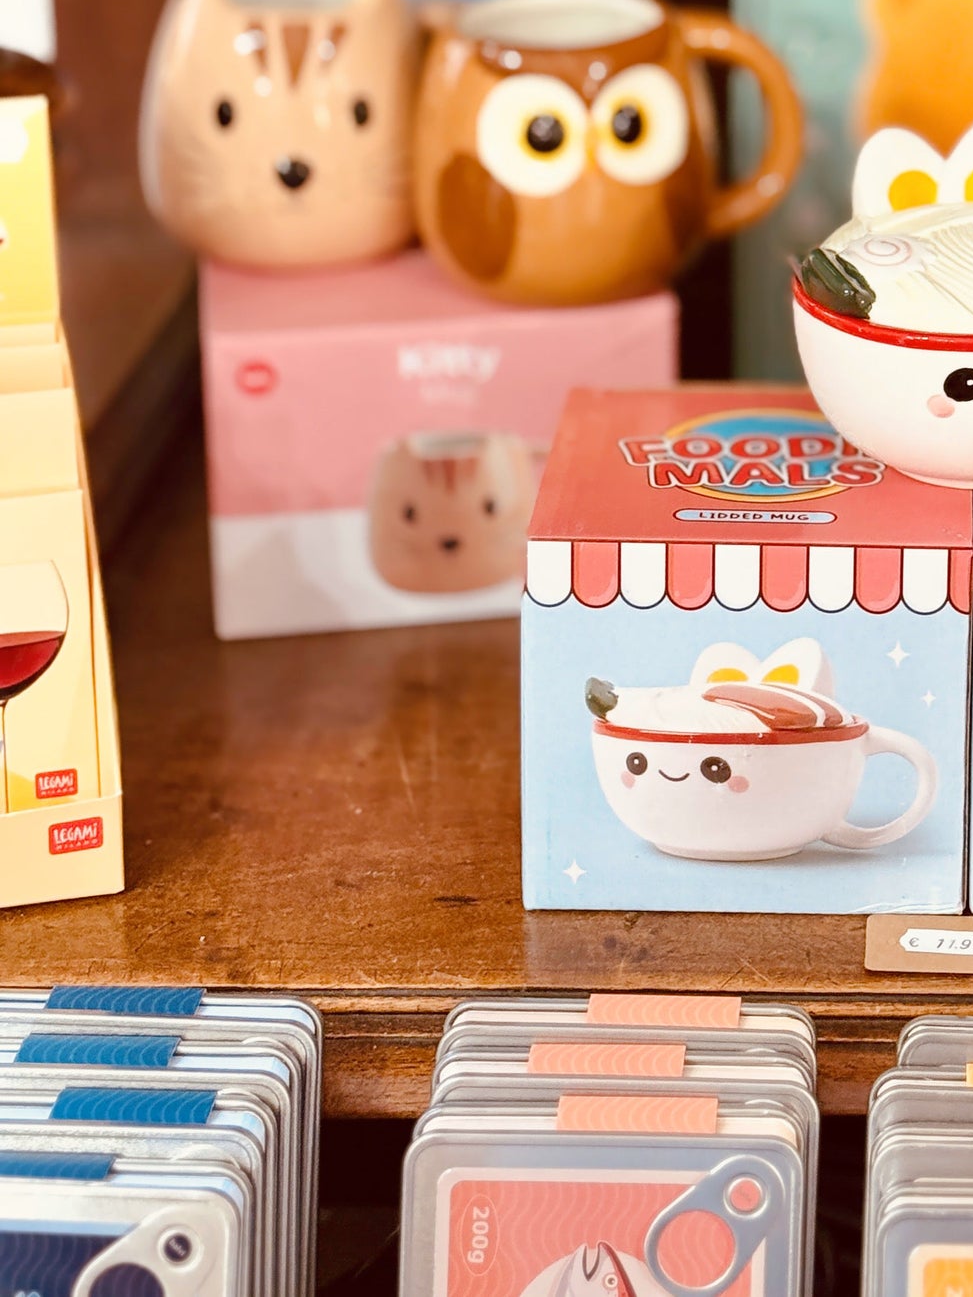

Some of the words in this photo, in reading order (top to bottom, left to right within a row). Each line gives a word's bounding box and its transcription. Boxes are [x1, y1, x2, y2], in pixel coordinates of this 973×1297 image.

[649, 459, 886, 488] MALS
[699, 511, 763, 521] LIDDED
[770, 512, 810, 522] MUG
[909, 937, 919, 948] €
[467, 1206, 490, 1264] 200g
